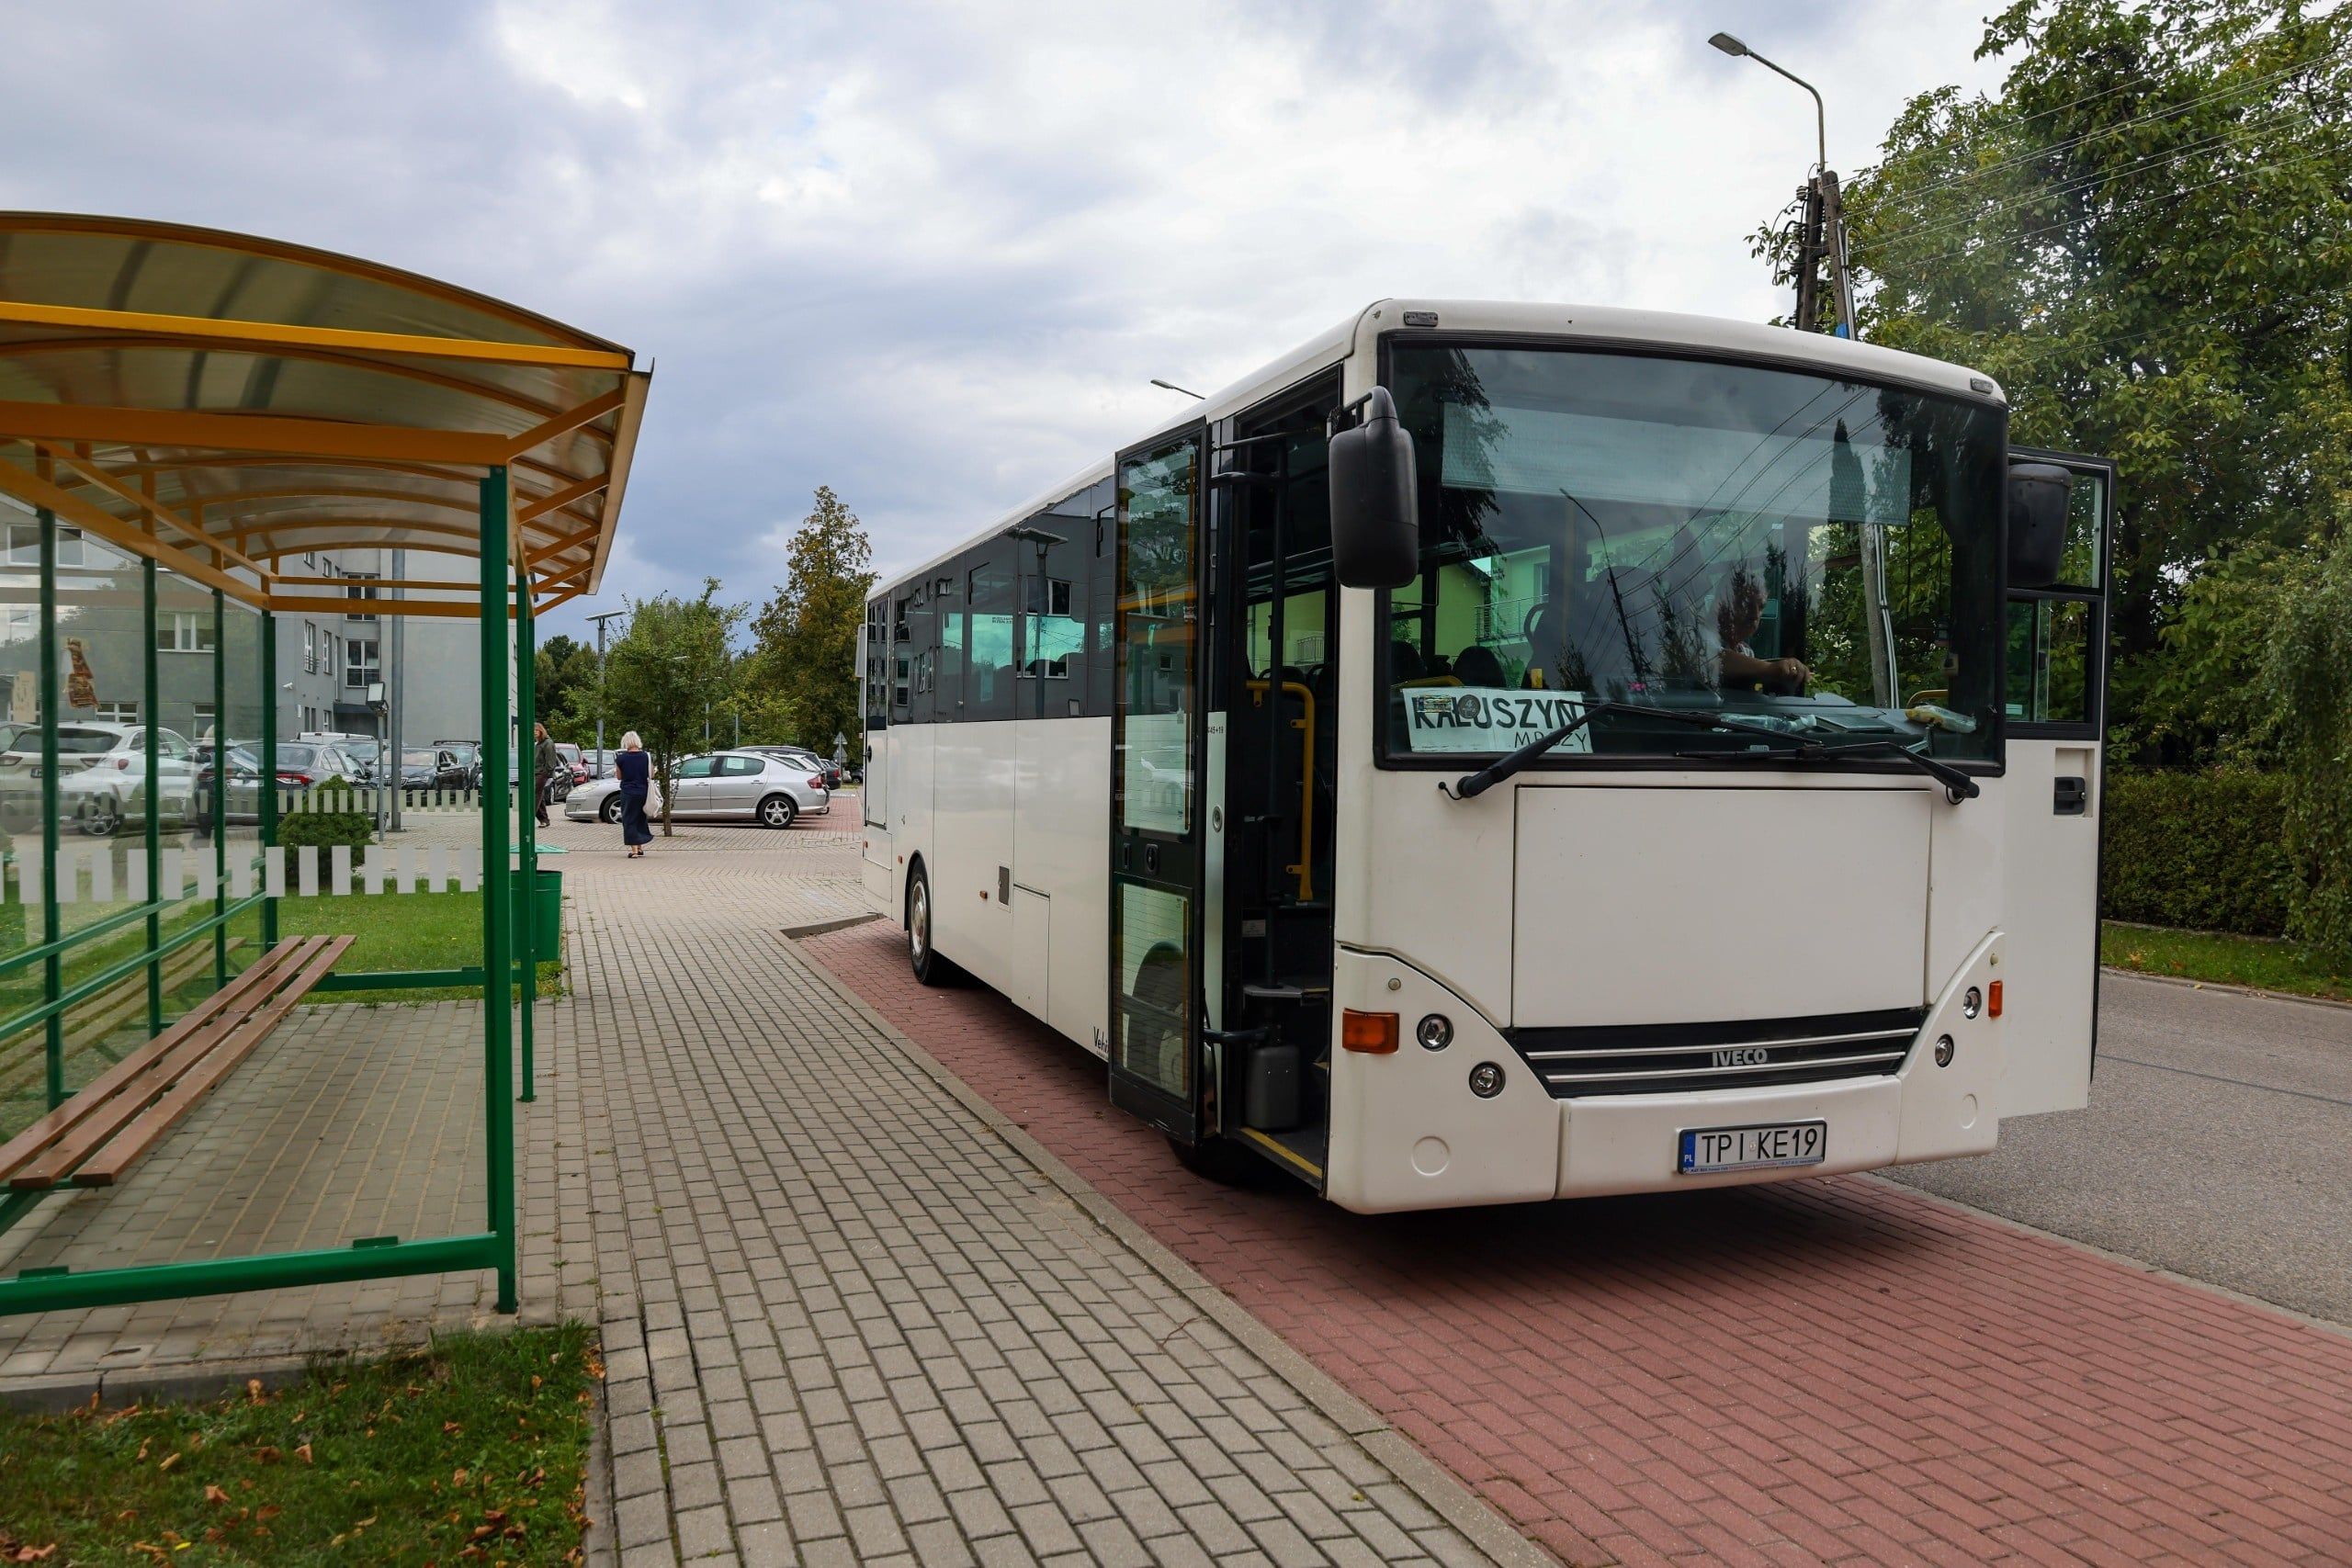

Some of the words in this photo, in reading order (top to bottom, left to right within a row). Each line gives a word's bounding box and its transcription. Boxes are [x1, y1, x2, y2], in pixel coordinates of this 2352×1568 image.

[1712, 1048, 1769, 1067] IVECO
[1757, 1128, 1817, 1159] KE19
[1684, 1154, 1693, 1163] PL
